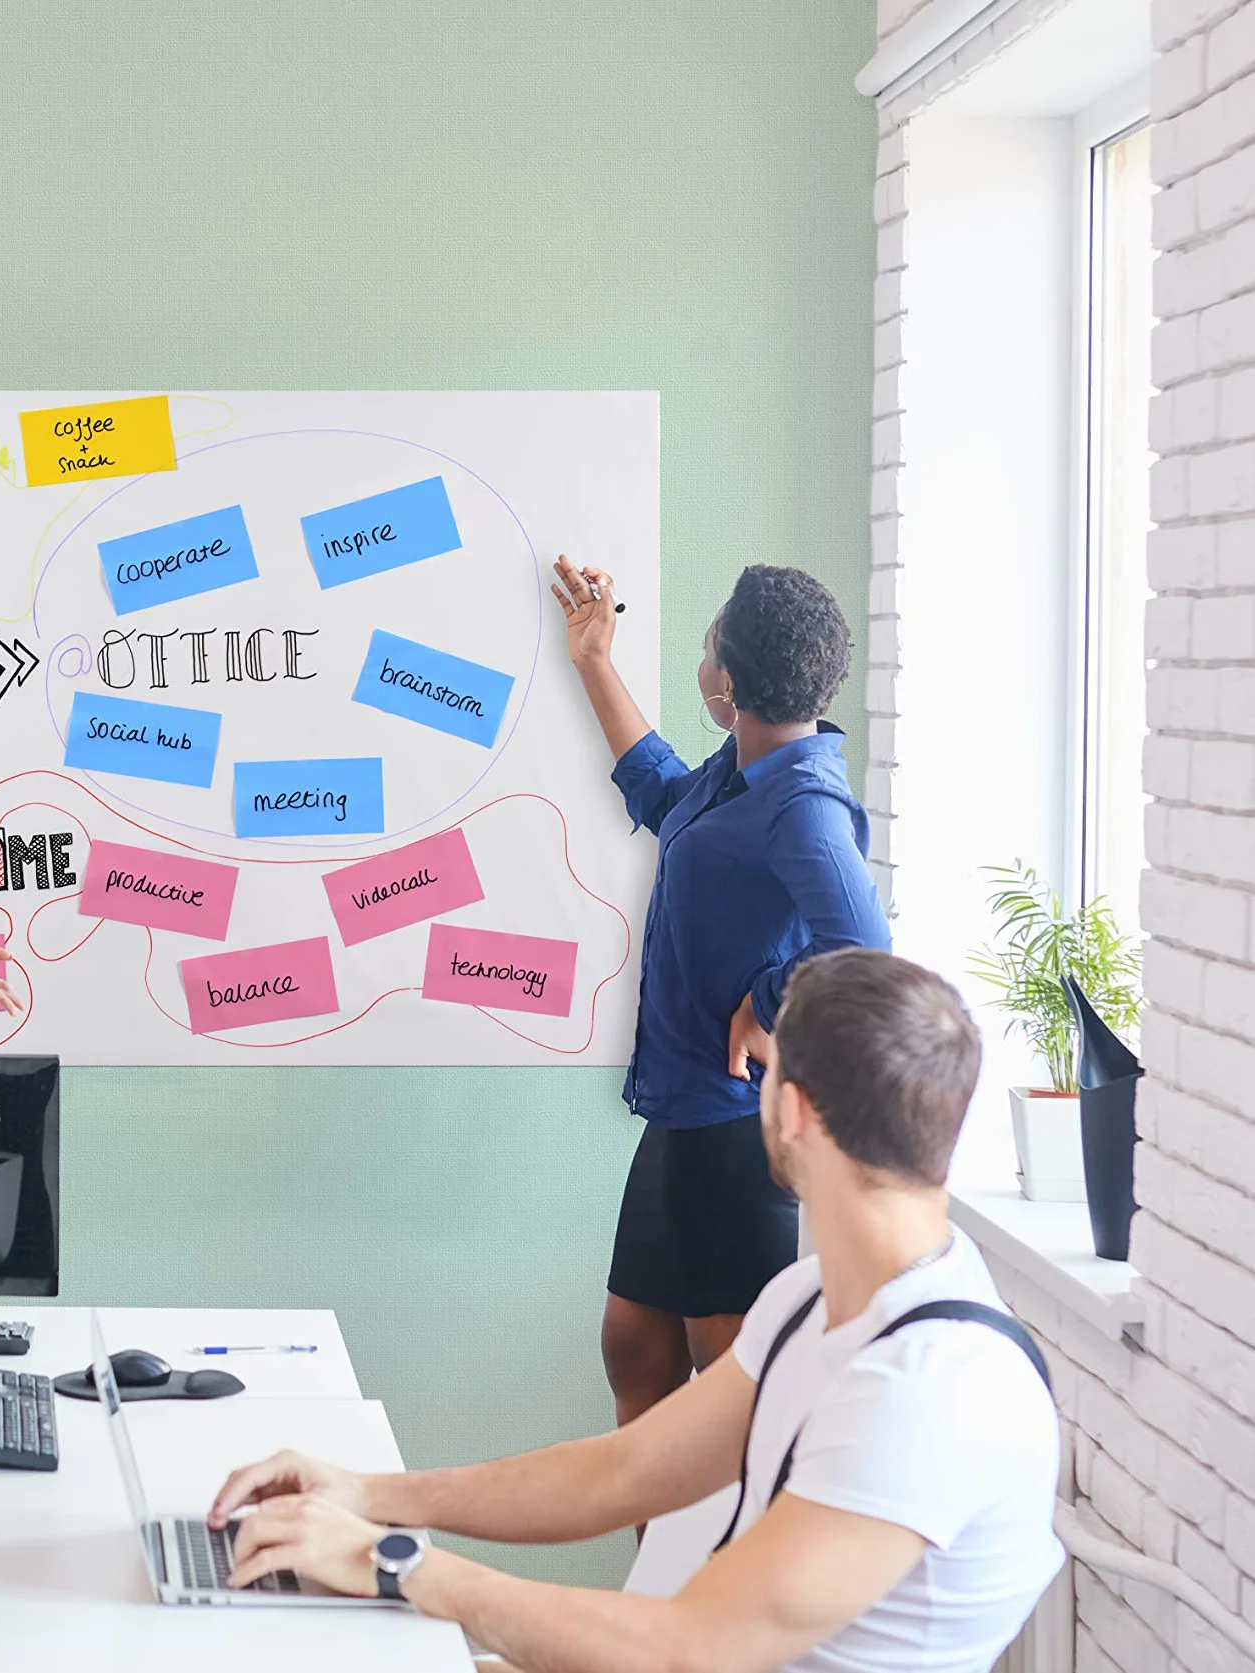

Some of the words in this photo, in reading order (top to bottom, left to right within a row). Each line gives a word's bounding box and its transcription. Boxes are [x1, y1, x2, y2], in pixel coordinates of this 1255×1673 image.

[54, 416, 115, 442] coffee
[79, 444, 89, 455] +
[322, 524, 398, 558] inspire
[117, 538, 231, 584] cooperate
[379, 657, 484, 718] brainstorm
[156, 728, 192, 750] hub
[254, 788, 347, 822] meeting
[105, 869, 204, 906] productive
[206, 975, 300, 1008] balance
[450, 952, 548, 999] technology
